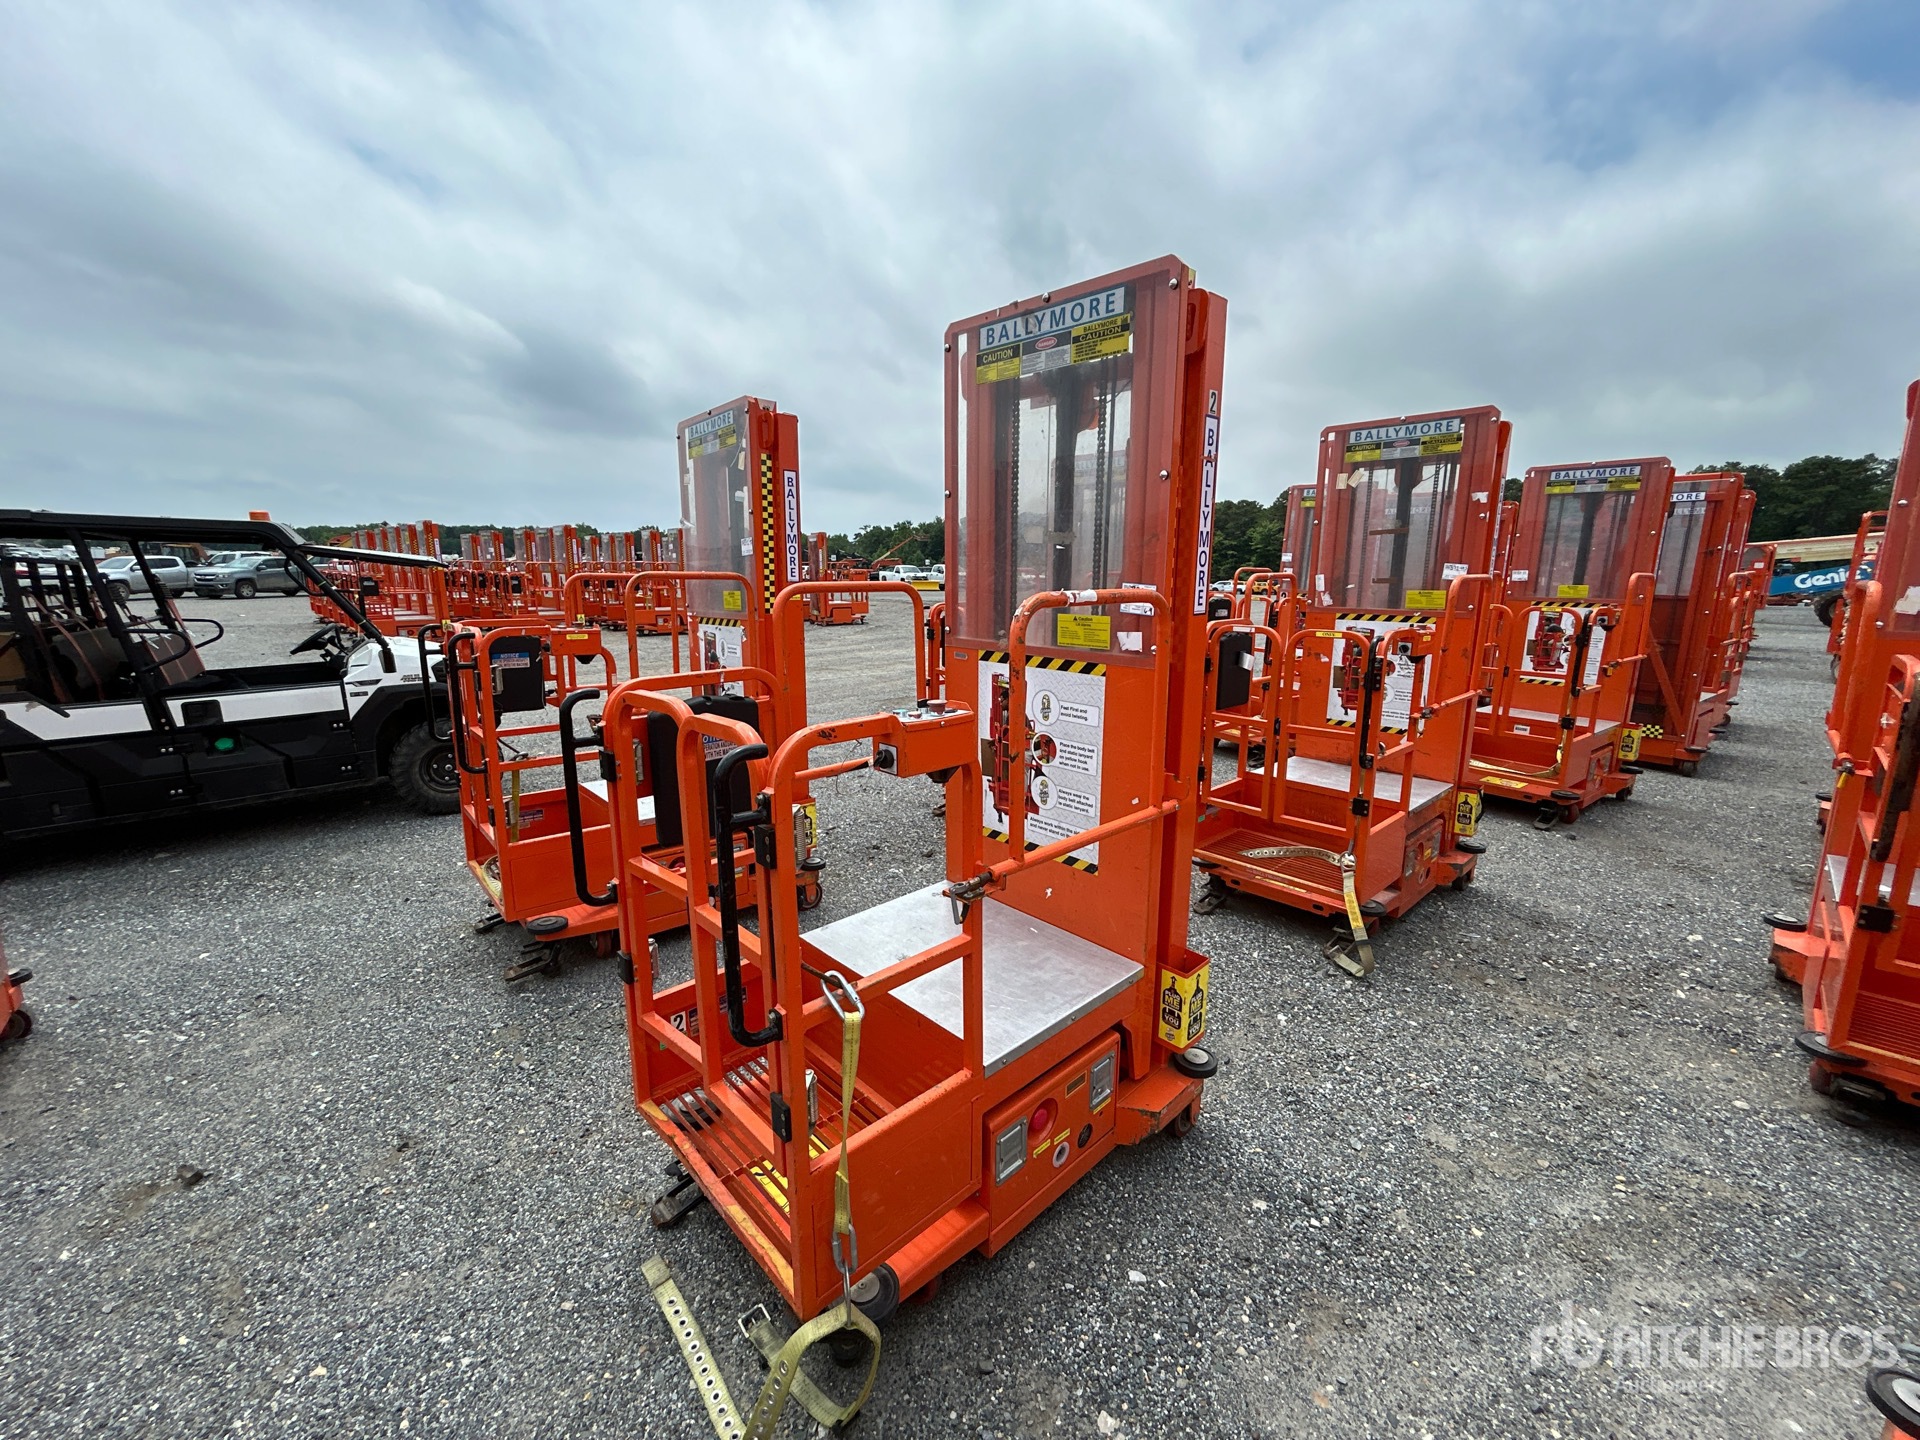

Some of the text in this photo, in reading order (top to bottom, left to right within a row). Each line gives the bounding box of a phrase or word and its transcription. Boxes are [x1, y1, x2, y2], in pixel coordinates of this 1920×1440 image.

[986, 292, 1116, 346] BALLYMORE
[1083, 318, 1118, 333] BALLYMORE
[1079, 326, 1122, 342] CAUTION
[982, 349, 1014, 364] CAUTION
[1210, 391, 1217, 414] 2
[690, 412, 731, 438] BALLYMORE
[1354, 420, 1455, 442] BALLYMORE
[1351, 443, 1376, 451] CAUTION
[1554, 466, 1636, 480] BALLYMORE
[1198, 428, 1215, 606] BALLYMORE
[787, 476, 797, 578] BALLYMORE
[1165, 995, 1180, 1008] ME
[673, 1013, 684, 1032] 2
[1164, 1014, 1179, 1026] YOU
